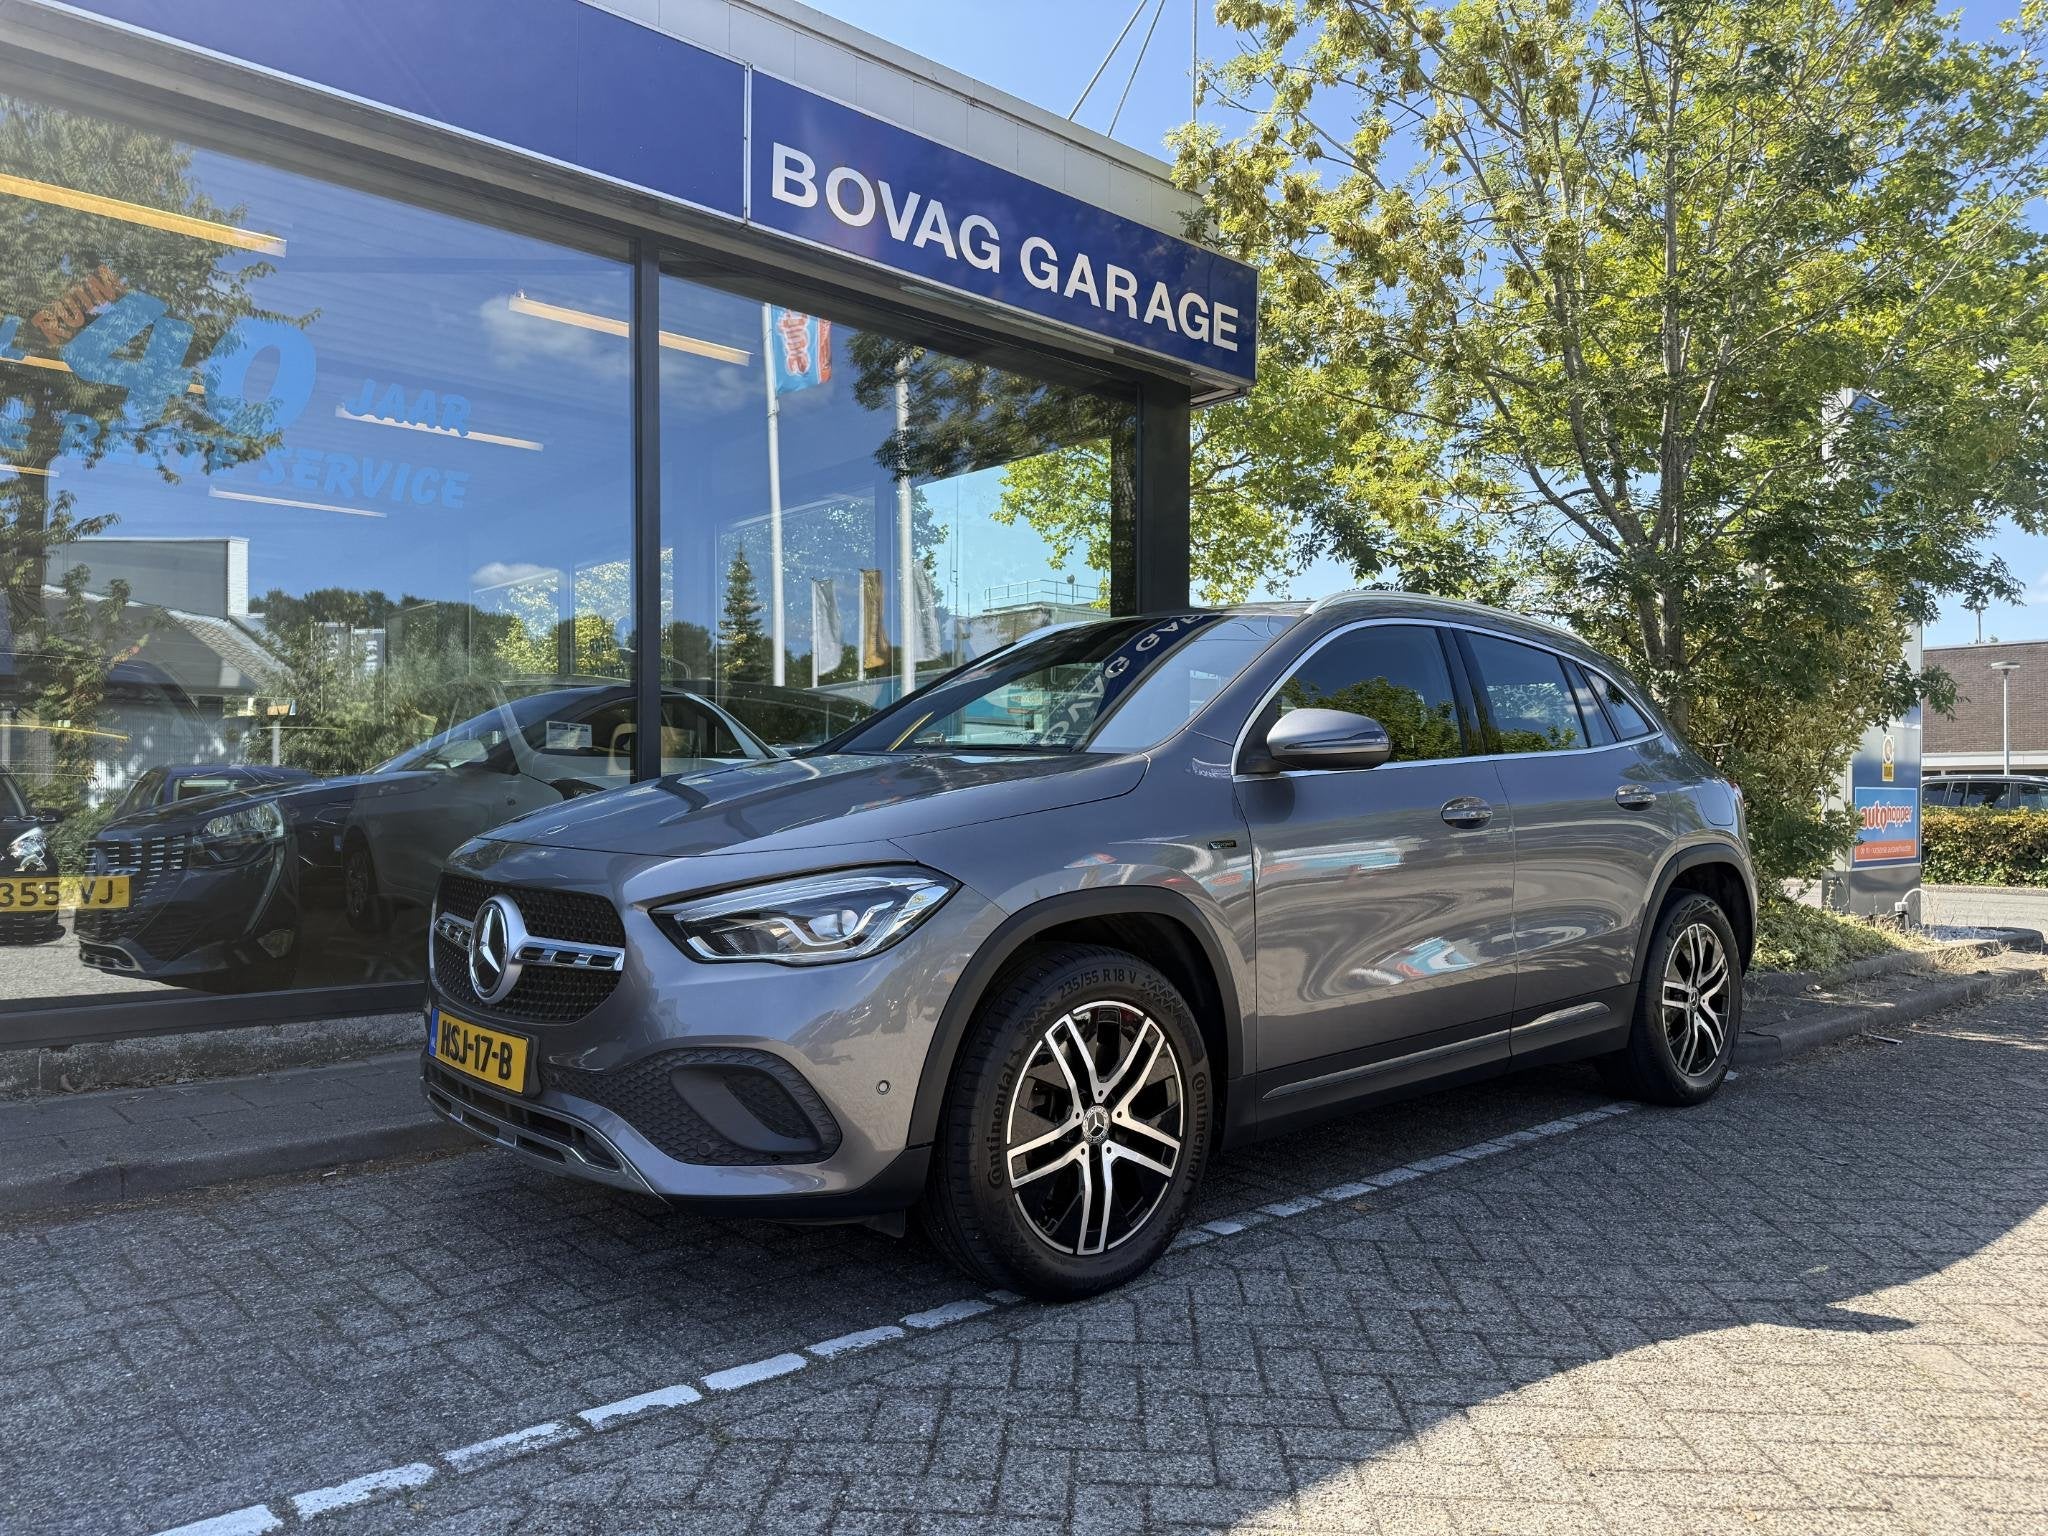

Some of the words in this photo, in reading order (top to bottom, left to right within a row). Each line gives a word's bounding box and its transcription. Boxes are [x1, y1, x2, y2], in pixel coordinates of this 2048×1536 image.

[771, 141, 1000, 273] BOVAG
[1019, 236, 1239, 352] GARAGE
[32, 264, 128, 346] RUIM
[60, 289, 317, 437] 40
[350, 377, 473, 438] JAAR
[256, 446, 472, 509] SERVICE
[1057, 969, 1100, 1000] 235/55
[440, 1020, 513, 1081] HSJ-17-B
